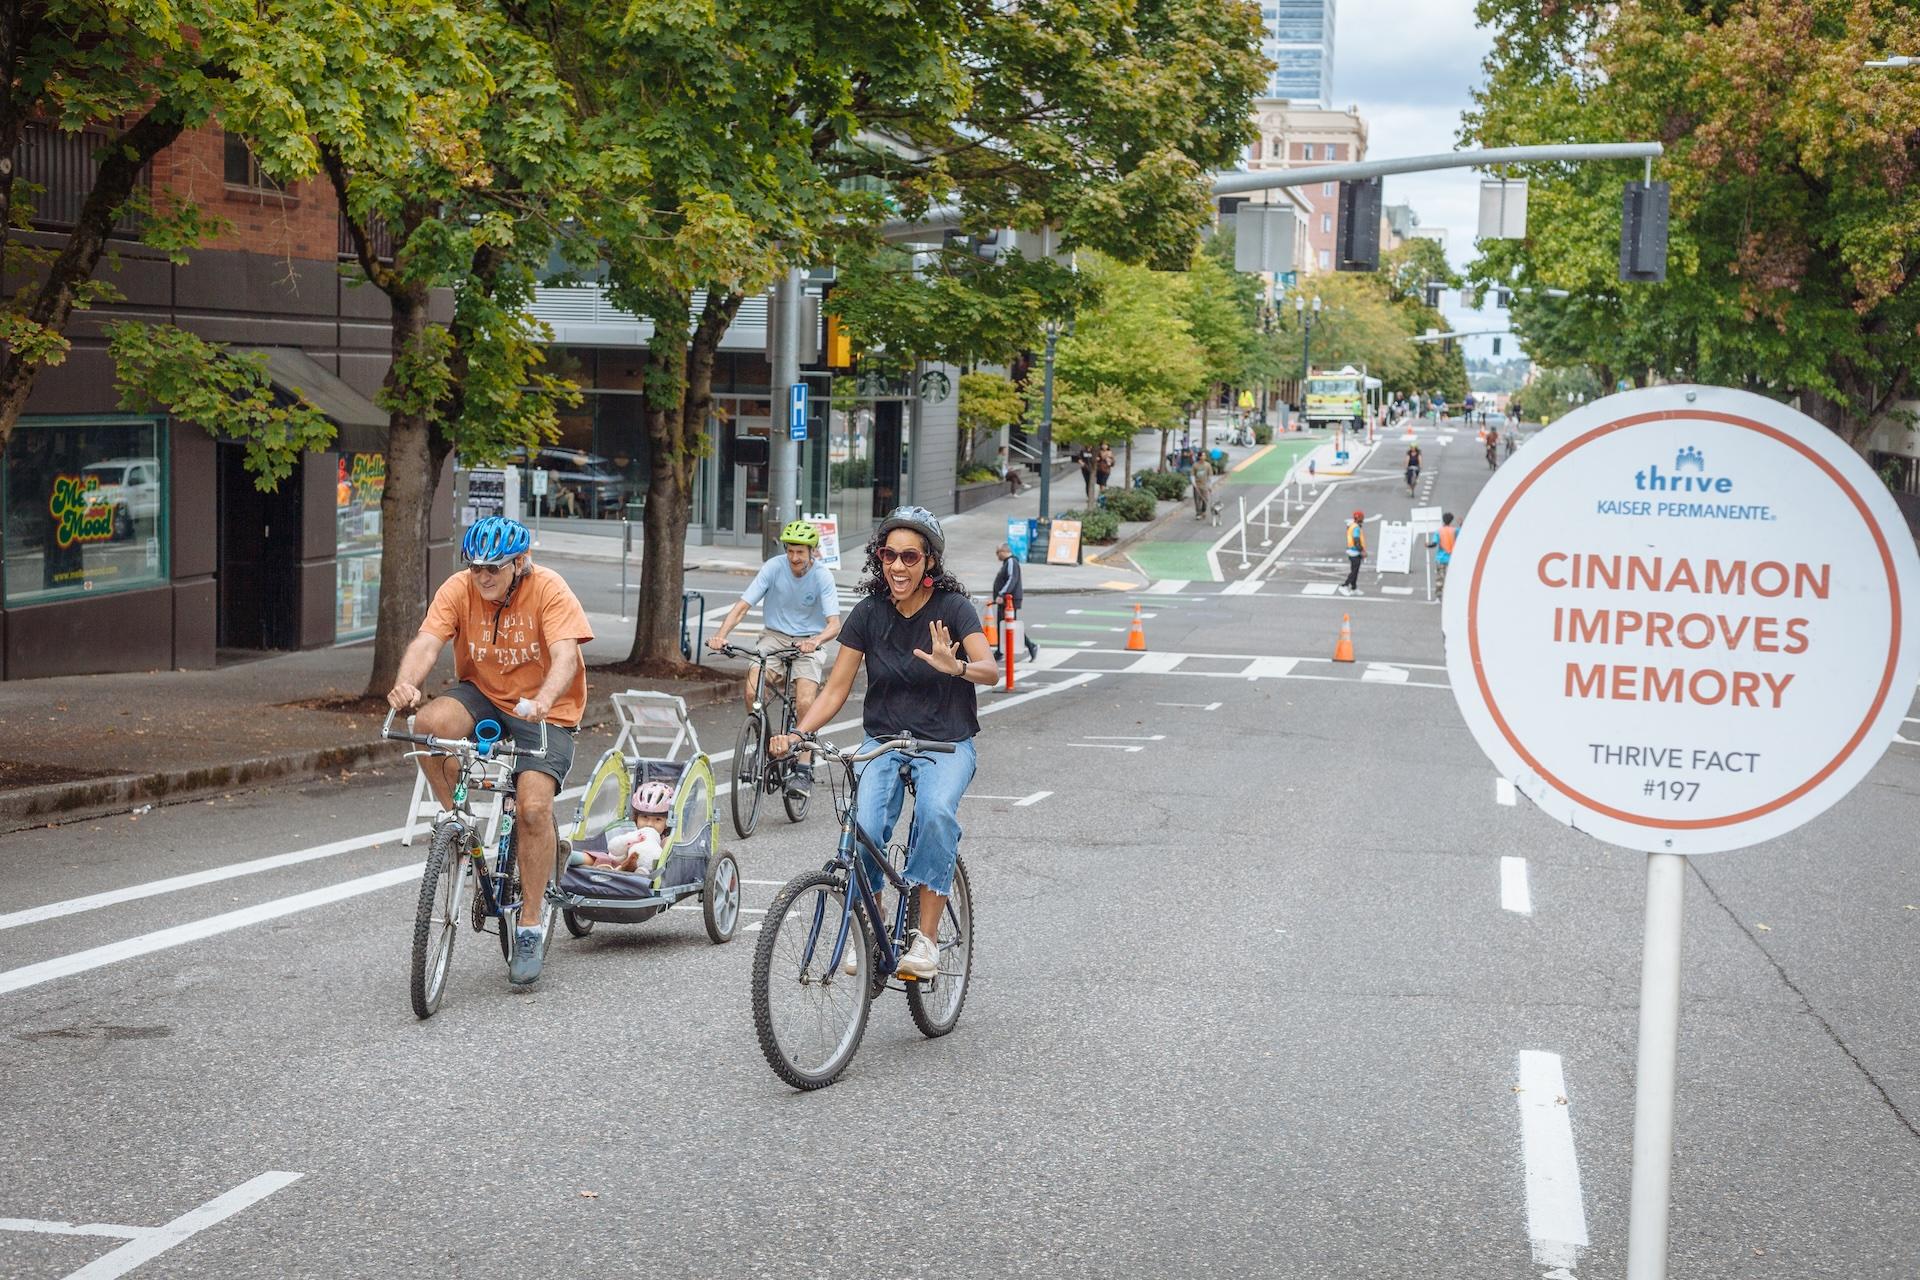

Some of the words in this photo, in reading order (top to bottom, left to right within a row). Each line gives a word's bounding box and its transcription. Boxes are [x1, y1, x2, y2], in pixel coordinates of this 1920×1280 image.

[793, 386, 805, 427] H
[1635, 465, 1733, 494] thrive
[1597, 500, 1652, 516] KAISER
[59, 508, 112, 544] Mood
[1537, 552, 1831, 600] CINNAMON
[1552, 607, 1810, 654] IMPROVES
[495, 642, 541, 666] TEXAS
[1564, 663, 1795, 708] MEMORY
[1588, 744, 1683, 769] THRIVE
[1692, 750, 1761, 773] FACT
[1643, 780, 1701, 802] #197
